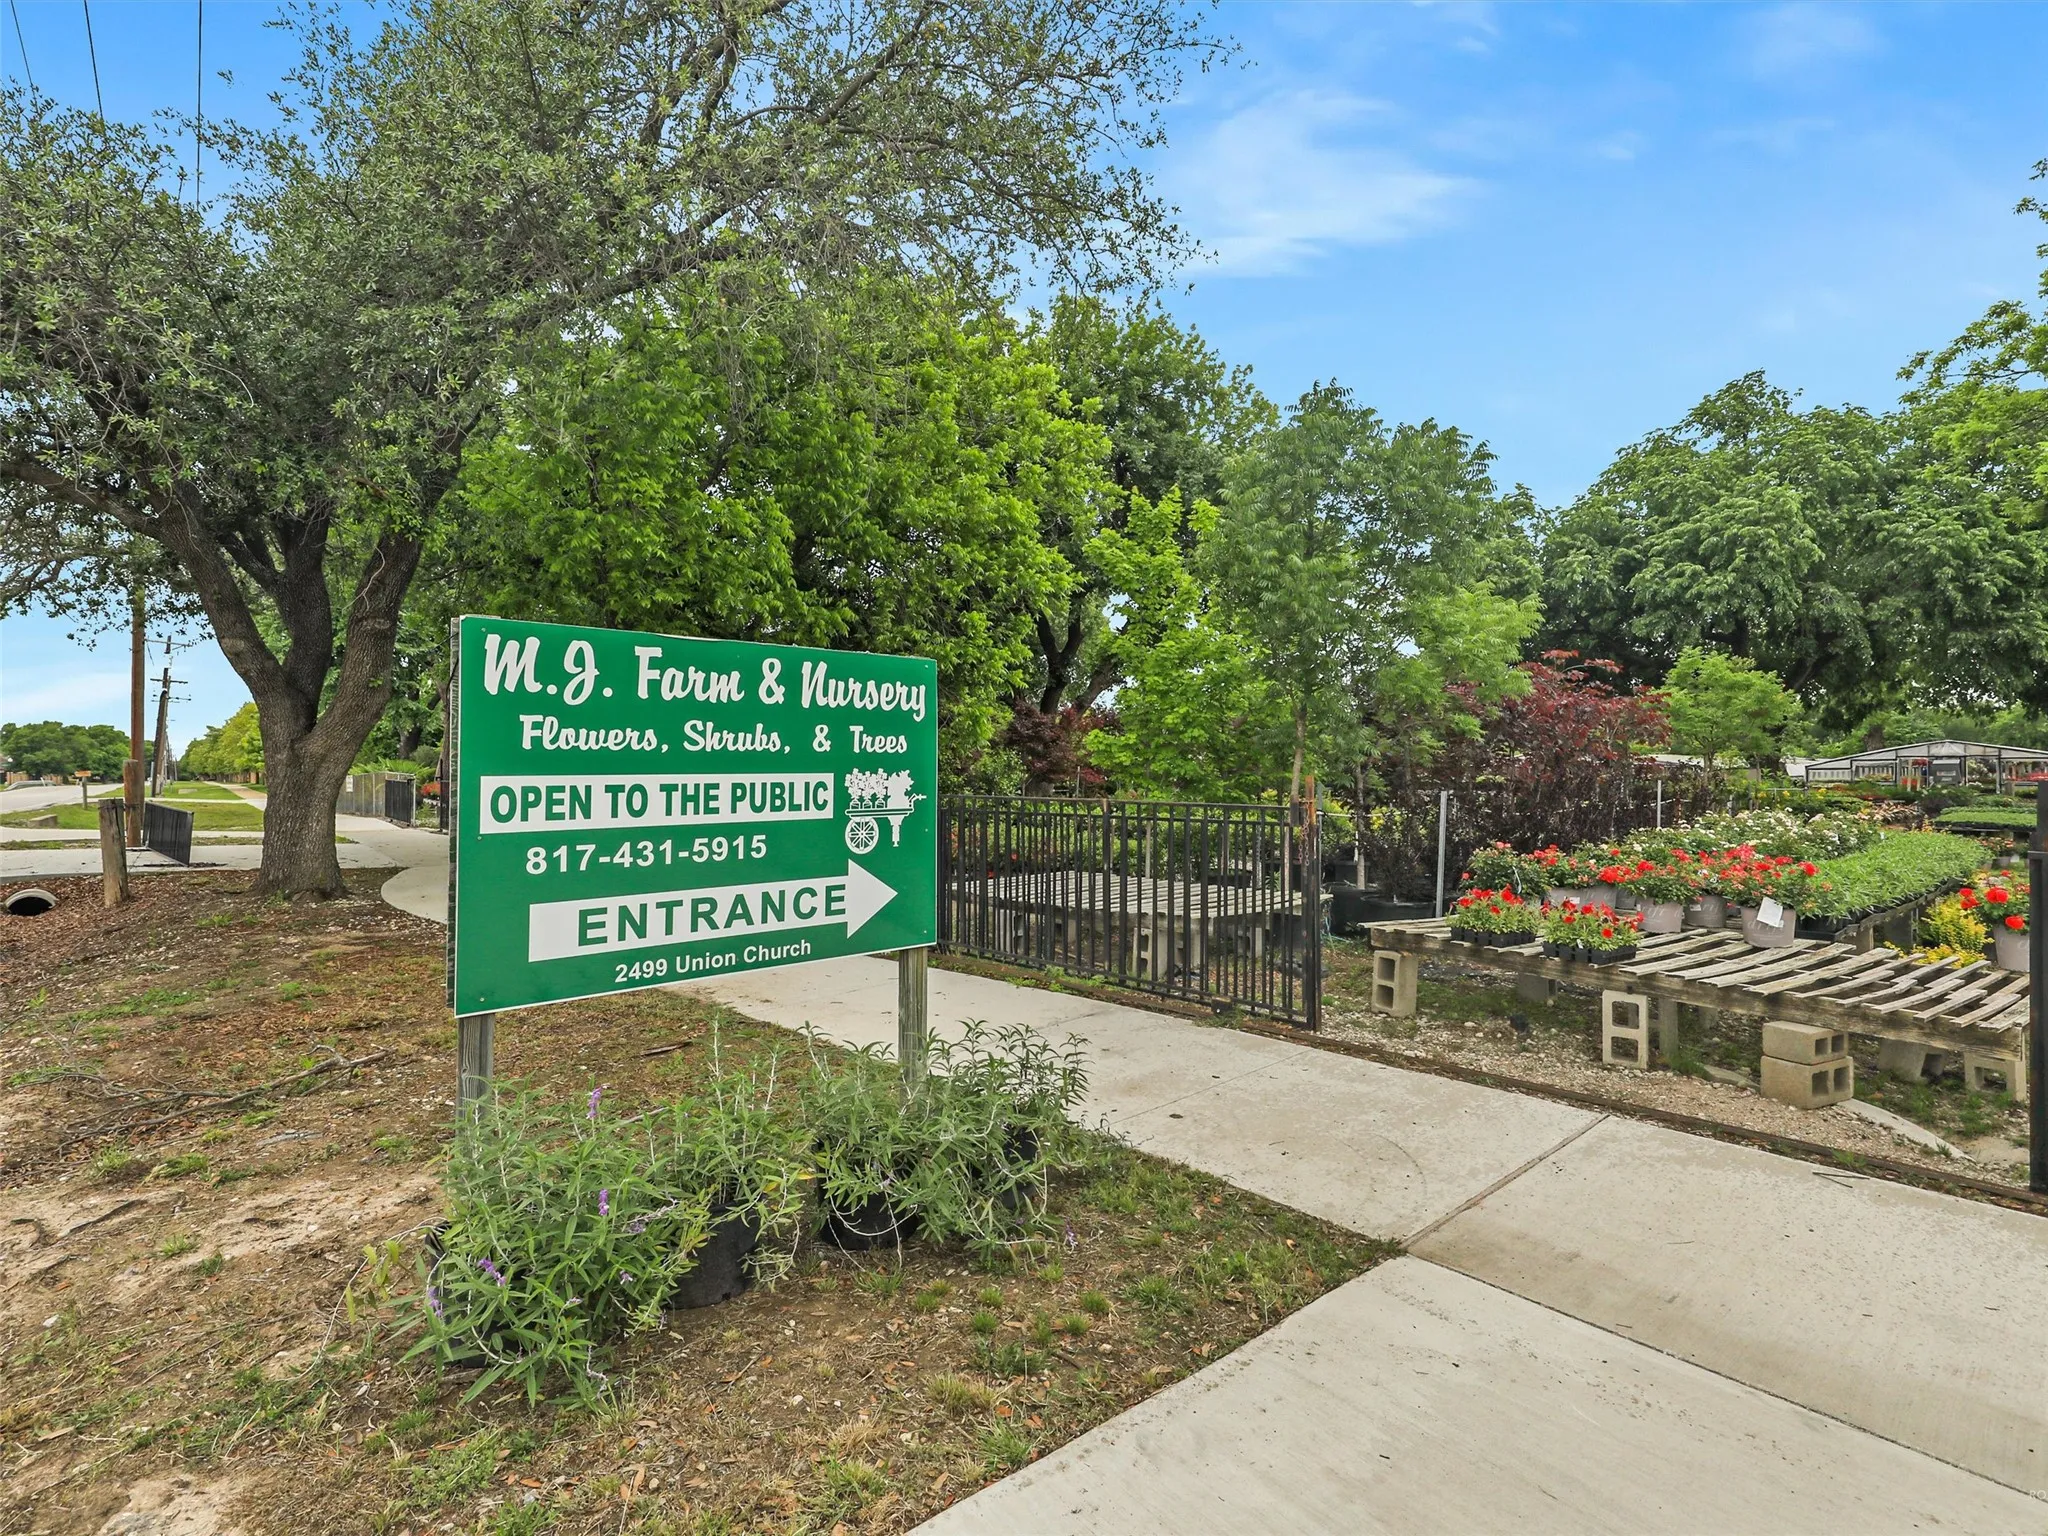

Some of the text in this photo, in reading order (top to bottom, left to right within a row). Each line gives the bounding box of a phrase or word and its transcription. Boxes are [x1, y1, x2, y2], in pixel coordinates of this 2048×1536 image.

[484, 634, 927, 722] M.J. Farm & Nursery
[520, 715, 908, 754] Flowers, Shrubs, & Trees
[491, 781, 829, 824] OPEN TO THE PUBLIC
[526, 835, 767, 875] 817-431-5915
[578, 884, 847, 947] ENTRANCE
[615, 939, 812, 983] 2499 Union Church
